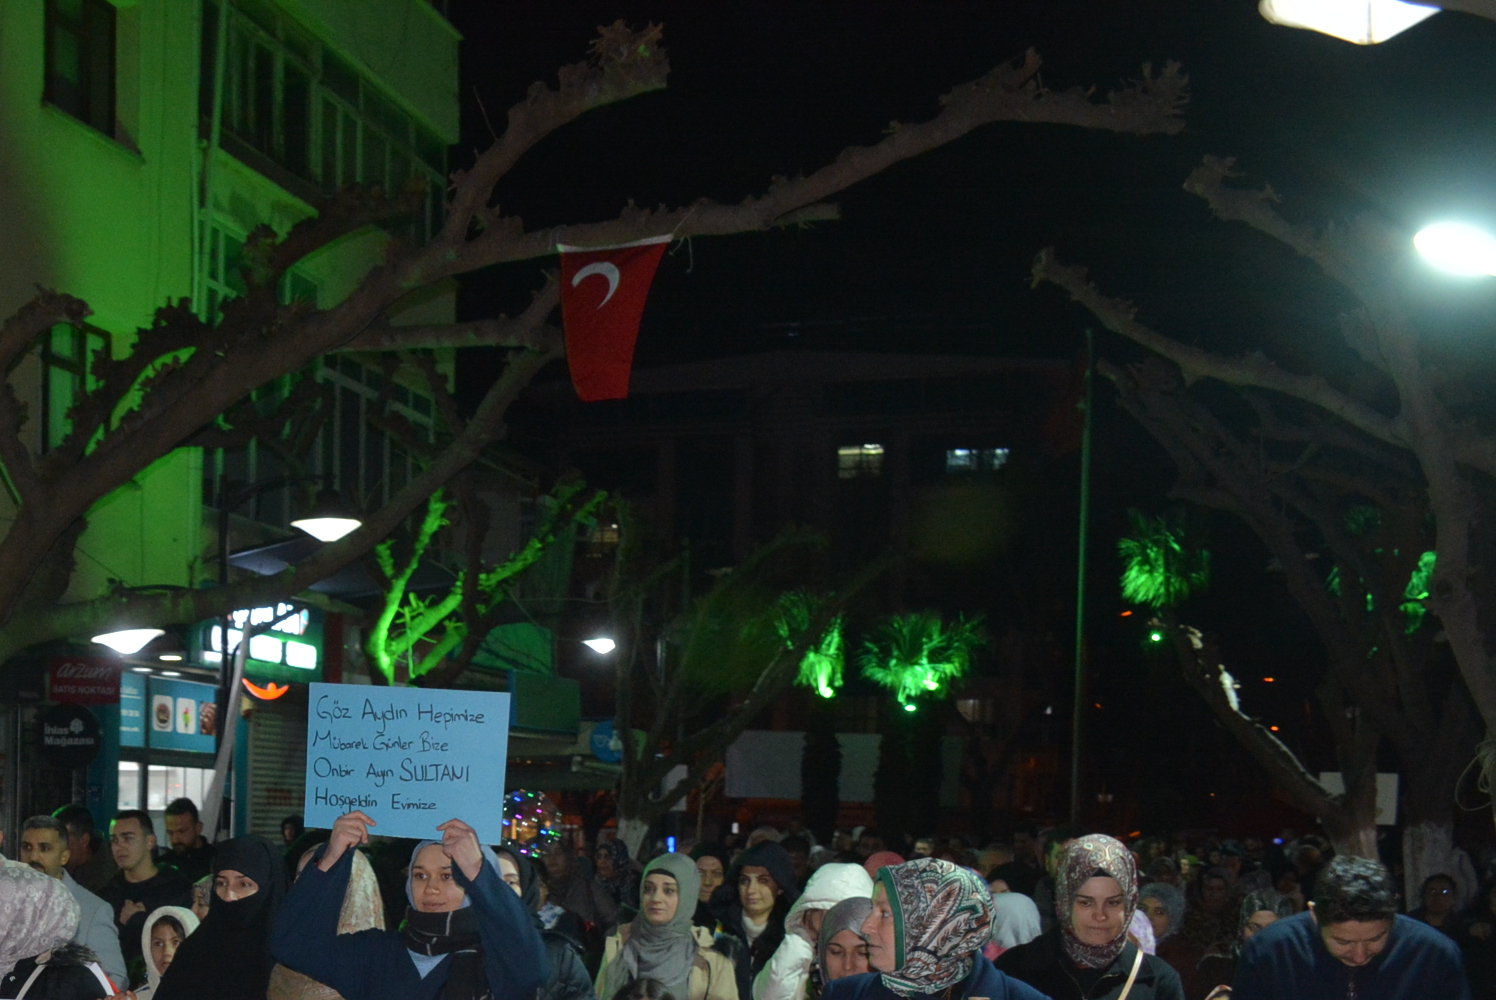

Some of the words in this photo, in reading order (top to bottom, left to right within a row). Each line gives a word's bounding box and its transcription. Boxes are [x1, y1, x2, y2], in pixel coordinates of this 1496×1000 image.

[316, 695, 352, 723] Göz
[361, 698, 408, 734] Aydın
[417, 702, 486, 731] Hepimize
[44, 736, 94, 747] Mağazası
[312, 729, 369, 751] Mübarek
[372, 733, 414, 751] Günler
[415, 730, 449, 753] Bize
[313, 756, 355, 778] Onbir
[365, 763, 395, 788] Ayın
[399, 757, 470, 782] SULTANI
[314, 786, 378, 815] Hoşgeldin
[391, 793, 437, 811] Evimize
